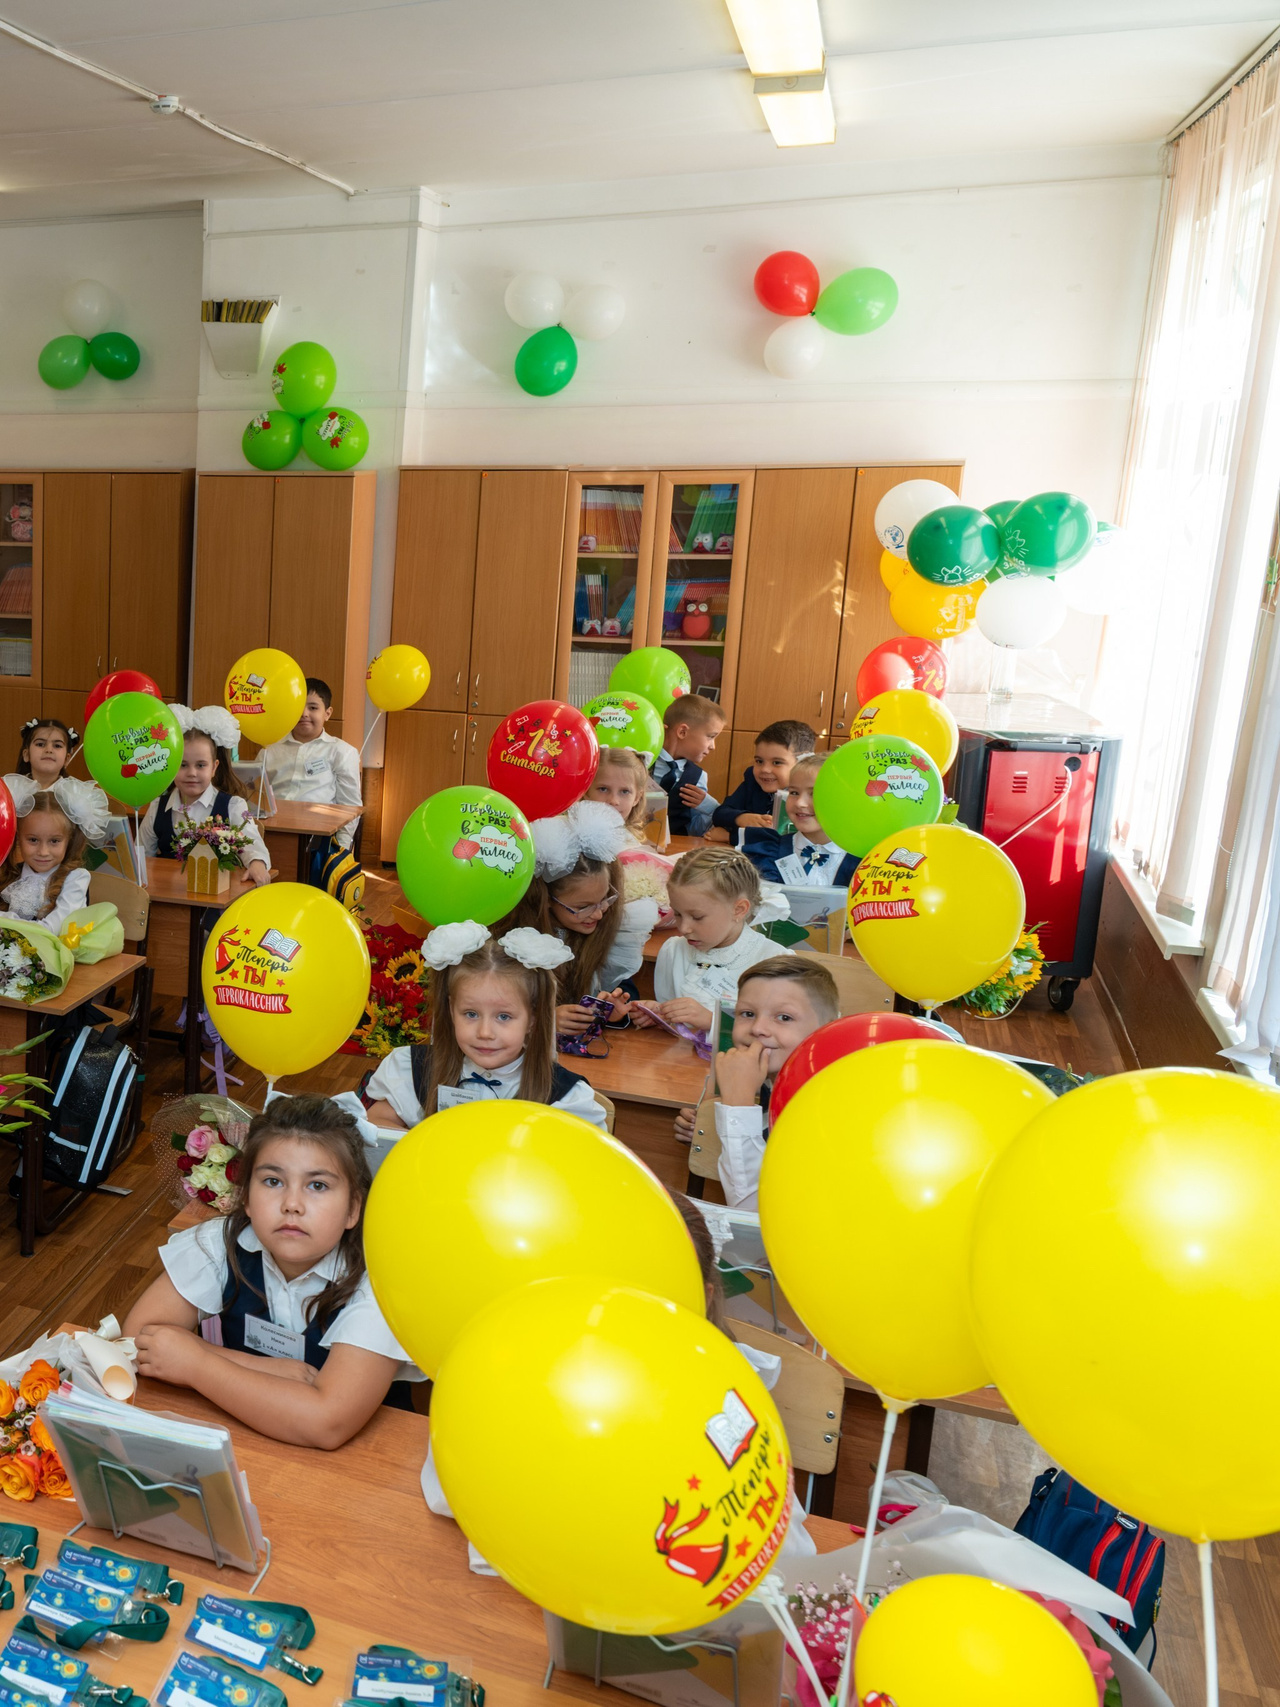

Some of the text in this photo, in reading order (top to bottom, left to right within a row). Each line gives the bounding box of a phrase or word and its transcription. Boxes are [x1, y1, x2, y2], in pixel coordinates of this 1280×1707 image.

[237, 683, 264, 694] Теперь
[240, 694, 252, 702] ТЫ
[111, 725, 150, 745] Первый
[133, 735, 149, 746] РАЗ
[854, 729, 864, 739] ТЫ
[527, 728, 545, 757] 1
[118, 749, 129, 762] в
[137, 753, 167, 771] класс
[863, 748, 911, 760] Первый
[889, 757, 908, 765] РАЗ
[500, 750, 556, 778] Сентября
[868, 765, 880, 777] в
[888, 781, 925, 791] класс
[460, 802, 511, 819] Первый
[461, 819, 474, 835] в
[488, 815, 507, 828] РАЗ
[480, 836, 508, 848] ПЕРВЫЙ
[480, 846, 519, 862] класс
[866, 865, 919, 881] Теперь
[872, 880, 892, 896] ТЫ
[852, 900, 913, 922] ПЕРВОКЛАССНИК
[236, 945, 294, 973] Теперь
[243, 965, 267, 988] ТЫ
[217, 987, 285, 1012] ПЕРВОКЛАССНИК
[715, 1422, 771, 1527] Теперь
[747, 1477, 780, 1531] ТЫ
